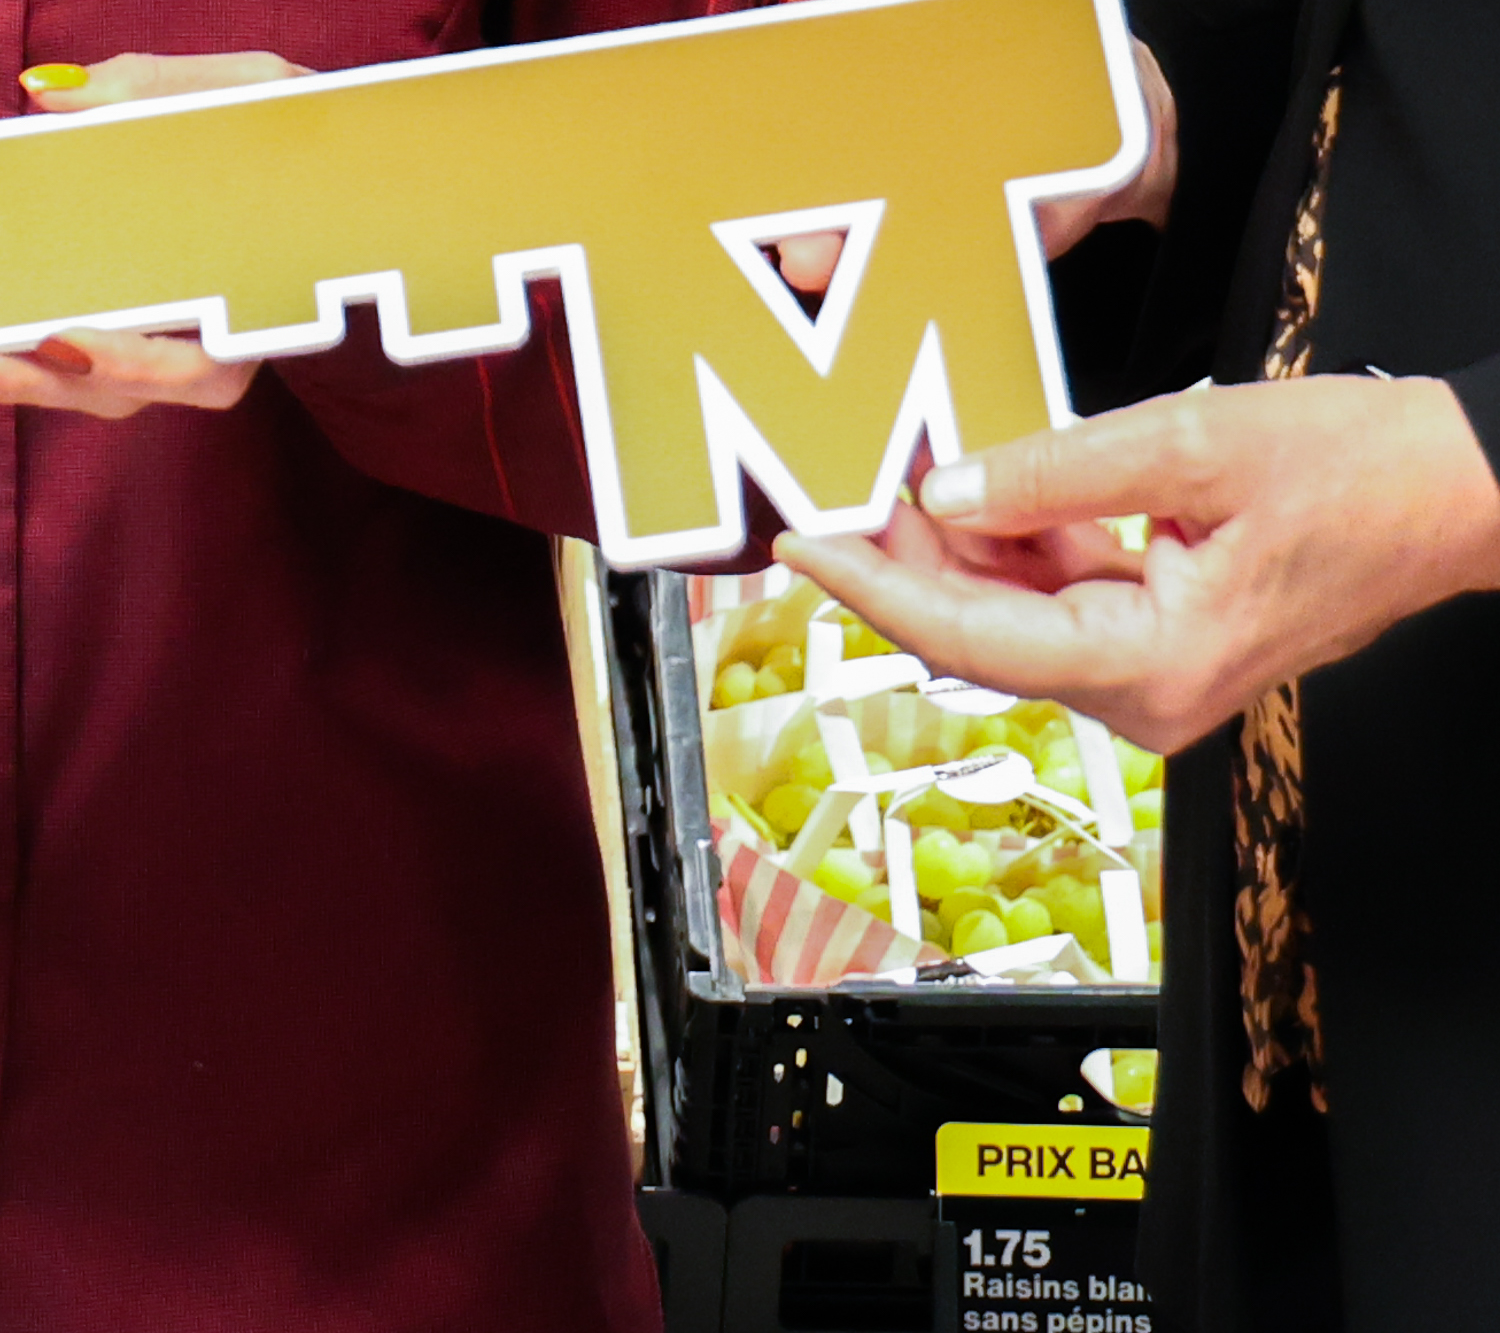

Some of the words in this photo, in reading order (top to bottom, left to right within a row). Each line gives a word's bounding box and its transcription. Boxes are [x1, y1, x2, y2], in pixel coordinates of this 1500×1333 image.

[977, 1143, 1076, 1179] PRIX
[1089, 1146, 1148, 1181] BA
[963, 1229, 1051, 1268] 1.75
[963, 1271, 1080, 1300] Raisins
[963, 1310, 1037, 1331] sans
[1046, 1306, 1152, 1333] pépins
